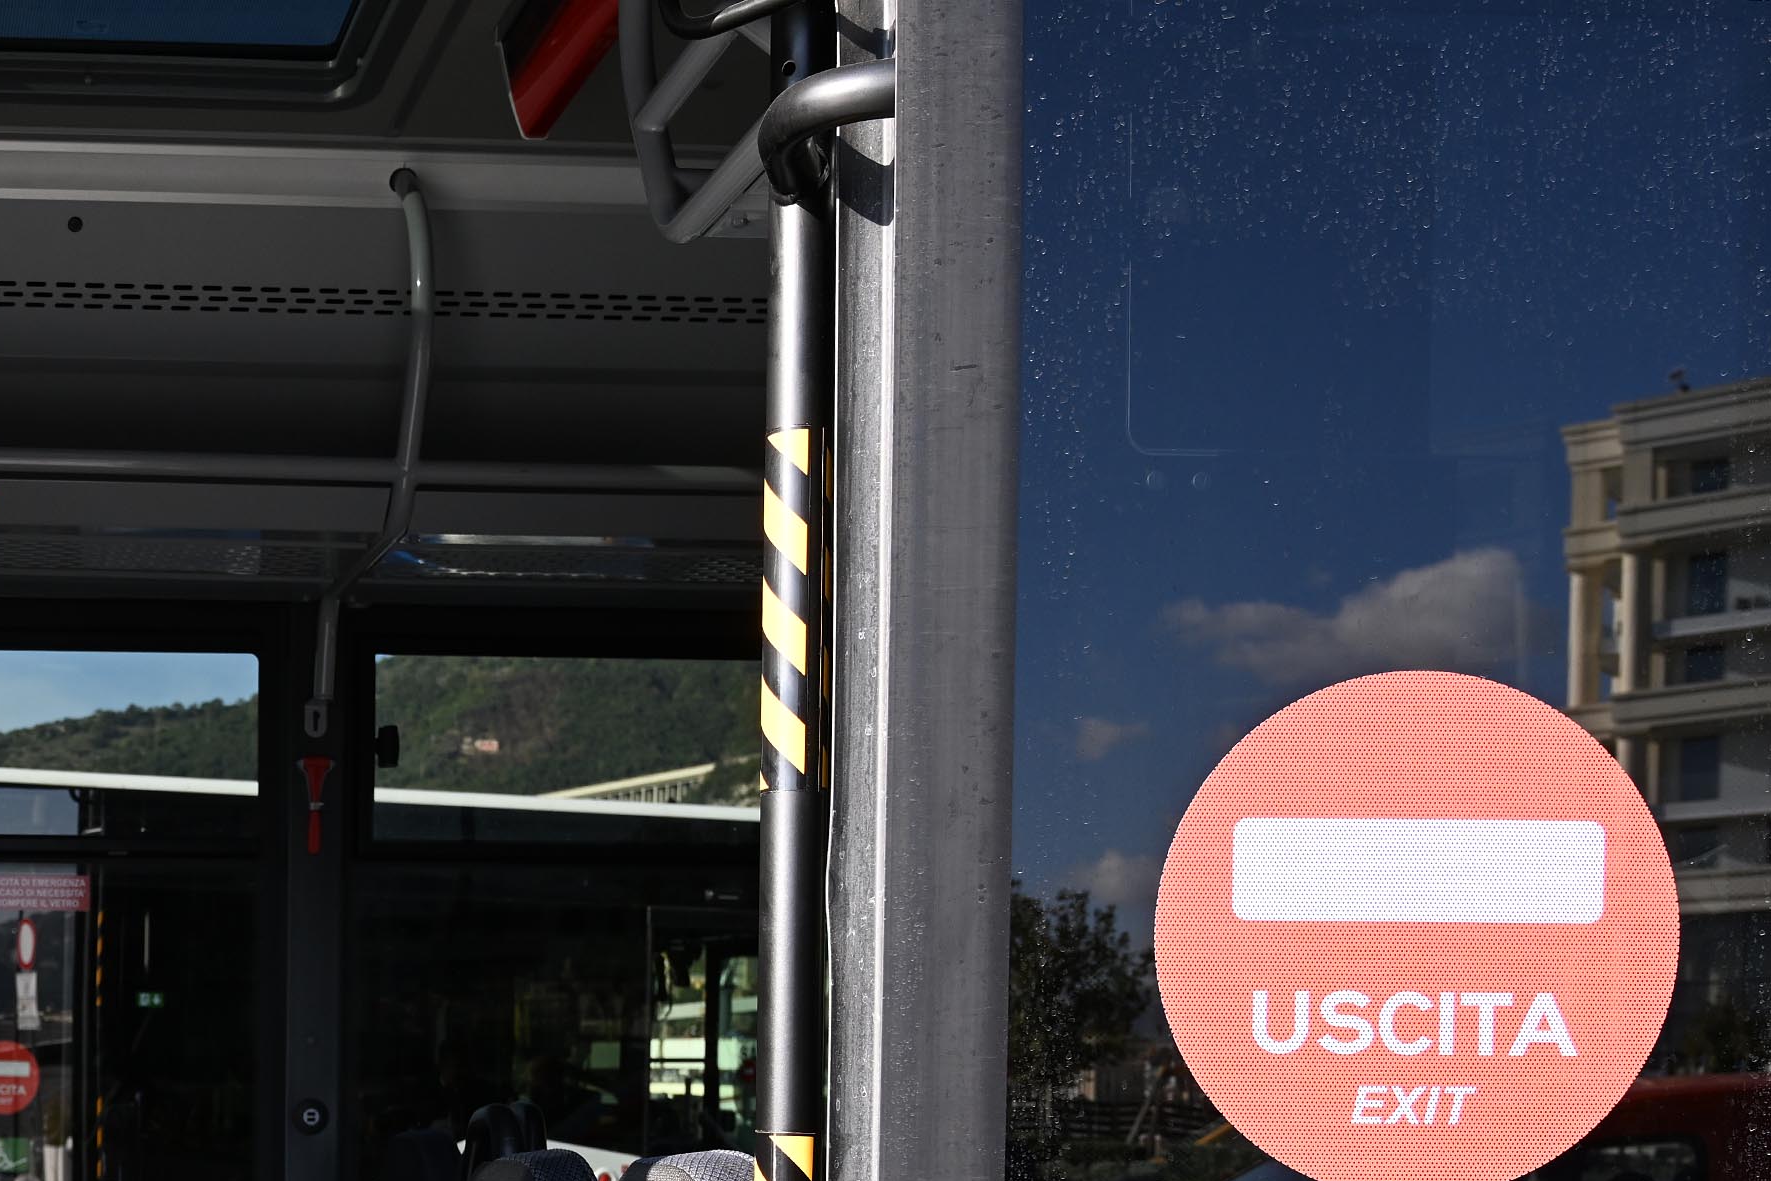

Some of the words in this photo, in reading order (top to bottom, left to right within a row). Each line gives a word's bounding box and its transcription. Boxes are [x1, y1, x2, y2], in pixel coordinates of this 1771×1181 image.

[32, 879, 85, 887] EMERGENZA
[40, 899, 48, 907] IL
[50, 899, 79, 908] VETRO
[1250, 989, 1579, 1057] USCITA
[1349, 1086, 1477, 1126] EXIT
